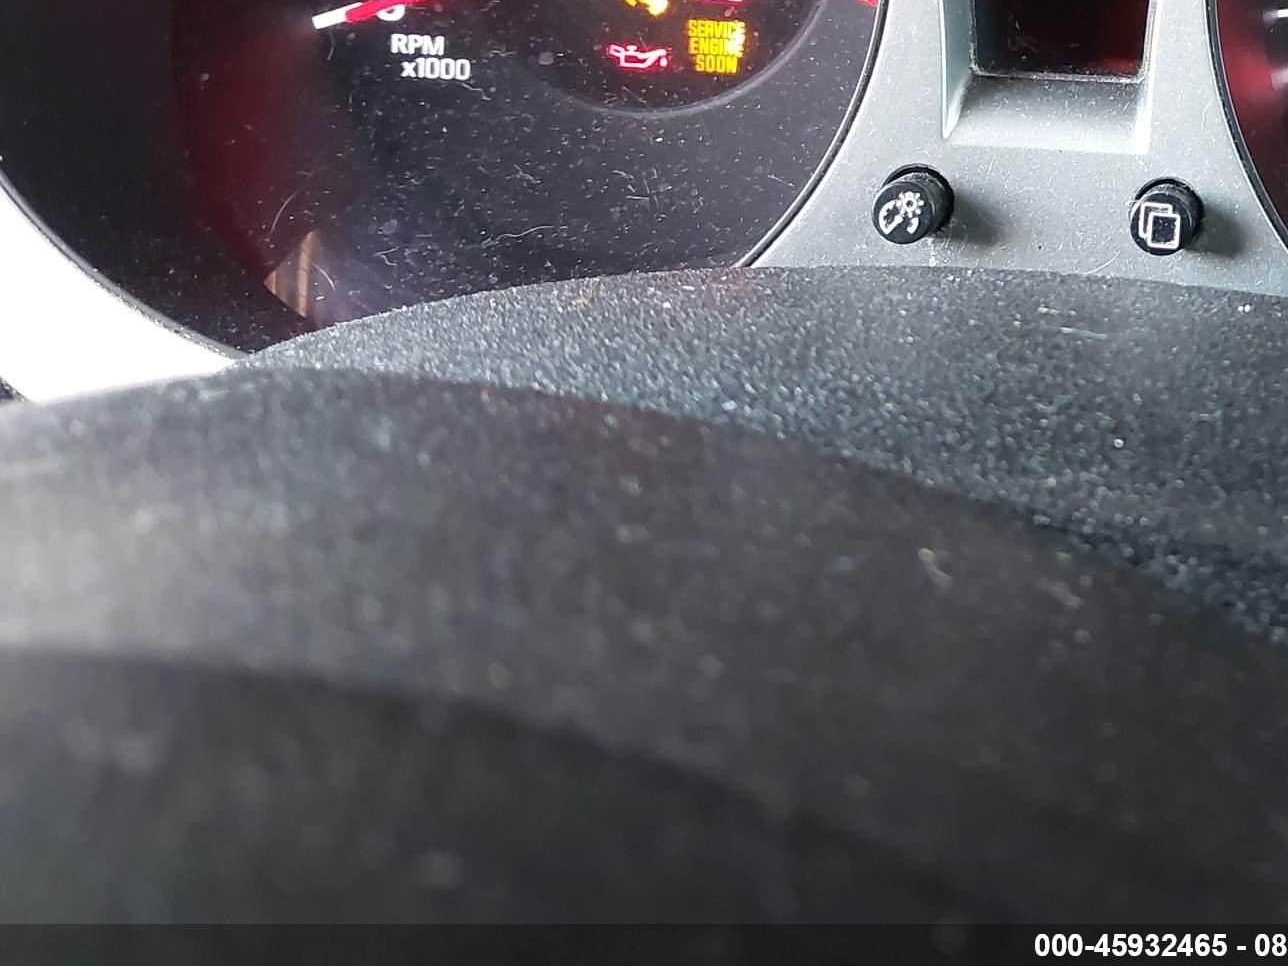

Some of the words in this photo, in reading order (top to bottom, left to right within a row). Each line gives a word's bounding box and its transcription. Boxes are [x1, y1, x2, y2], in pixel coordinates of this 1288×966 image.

[688, 19, 746, 38] SERVICE
[391, 33, 445, 55] RPM
[400, 57, 471, 80] x1000
[695, 54, 738, 73] SOON
